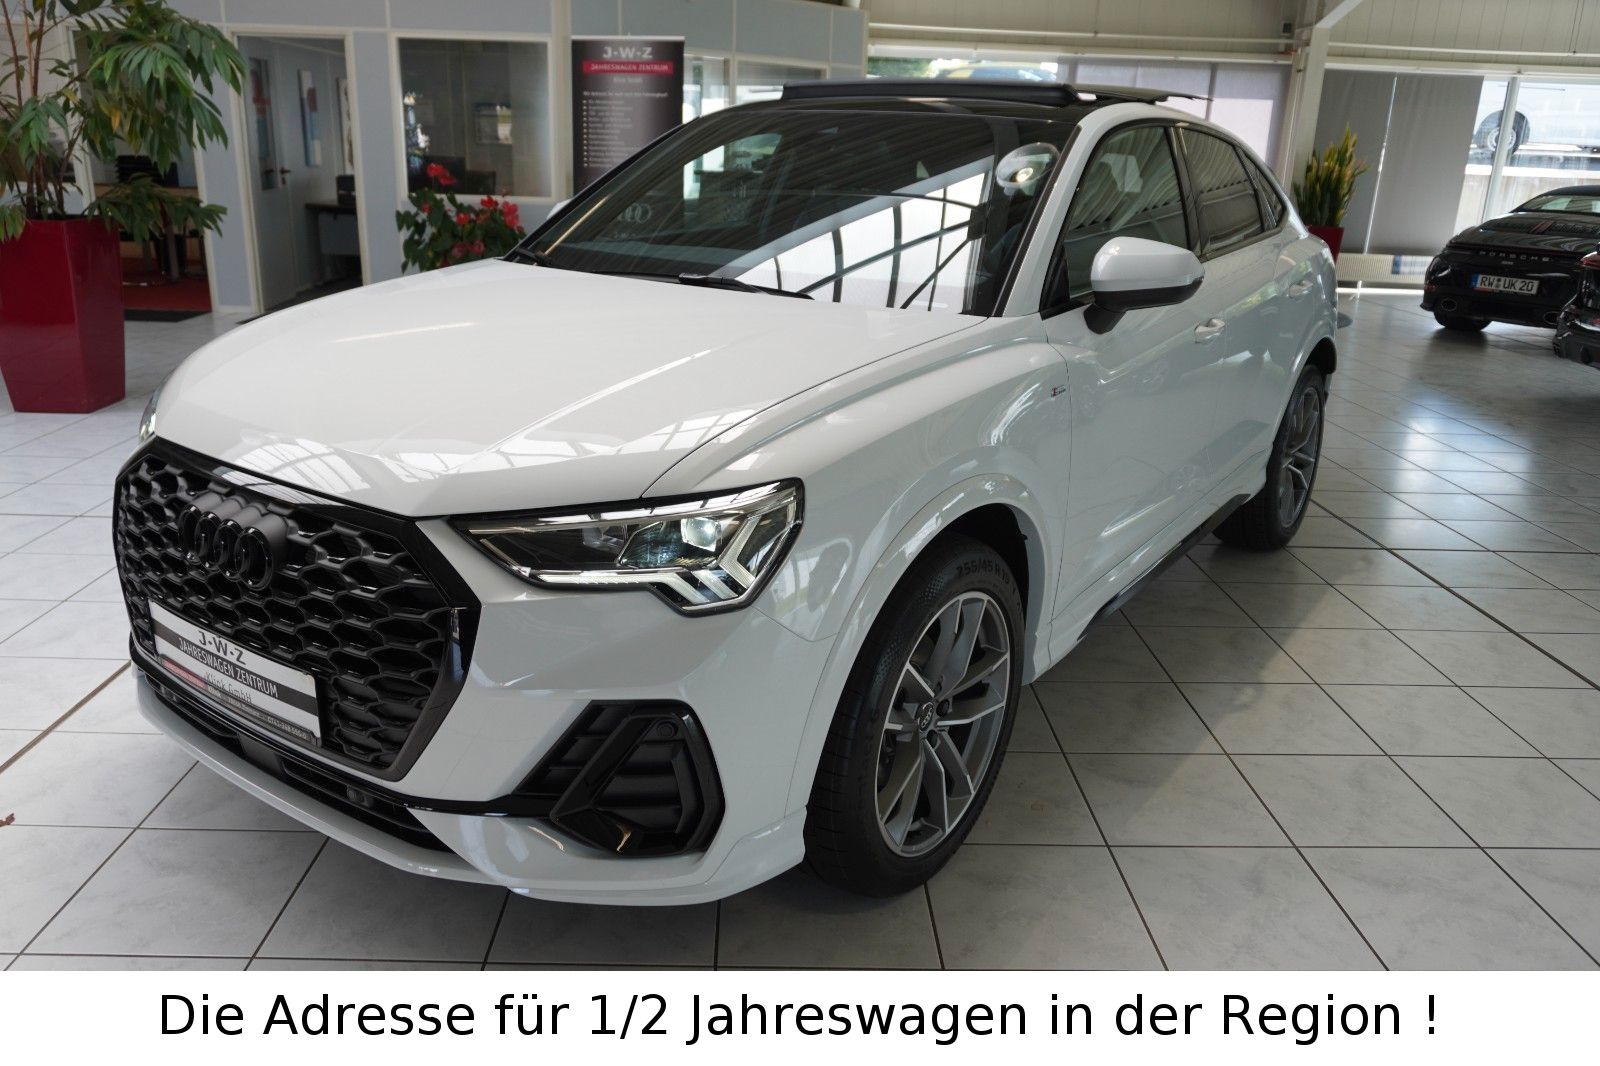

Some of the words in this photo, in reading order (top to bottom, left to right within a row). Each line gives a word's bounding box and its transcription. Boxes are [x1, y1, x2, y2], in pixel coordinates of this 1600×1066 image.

[639, 63, 669, 71] ZENTRUM
[1480, 276, 1495, 288] RW
[1503, 278, 1517, 290] UK
[1519, 280, 1534, 292] 20
[178, 637, 235, 679] JAHRESWAGEN
[235, 667, 279, 699] ZENTRUM
